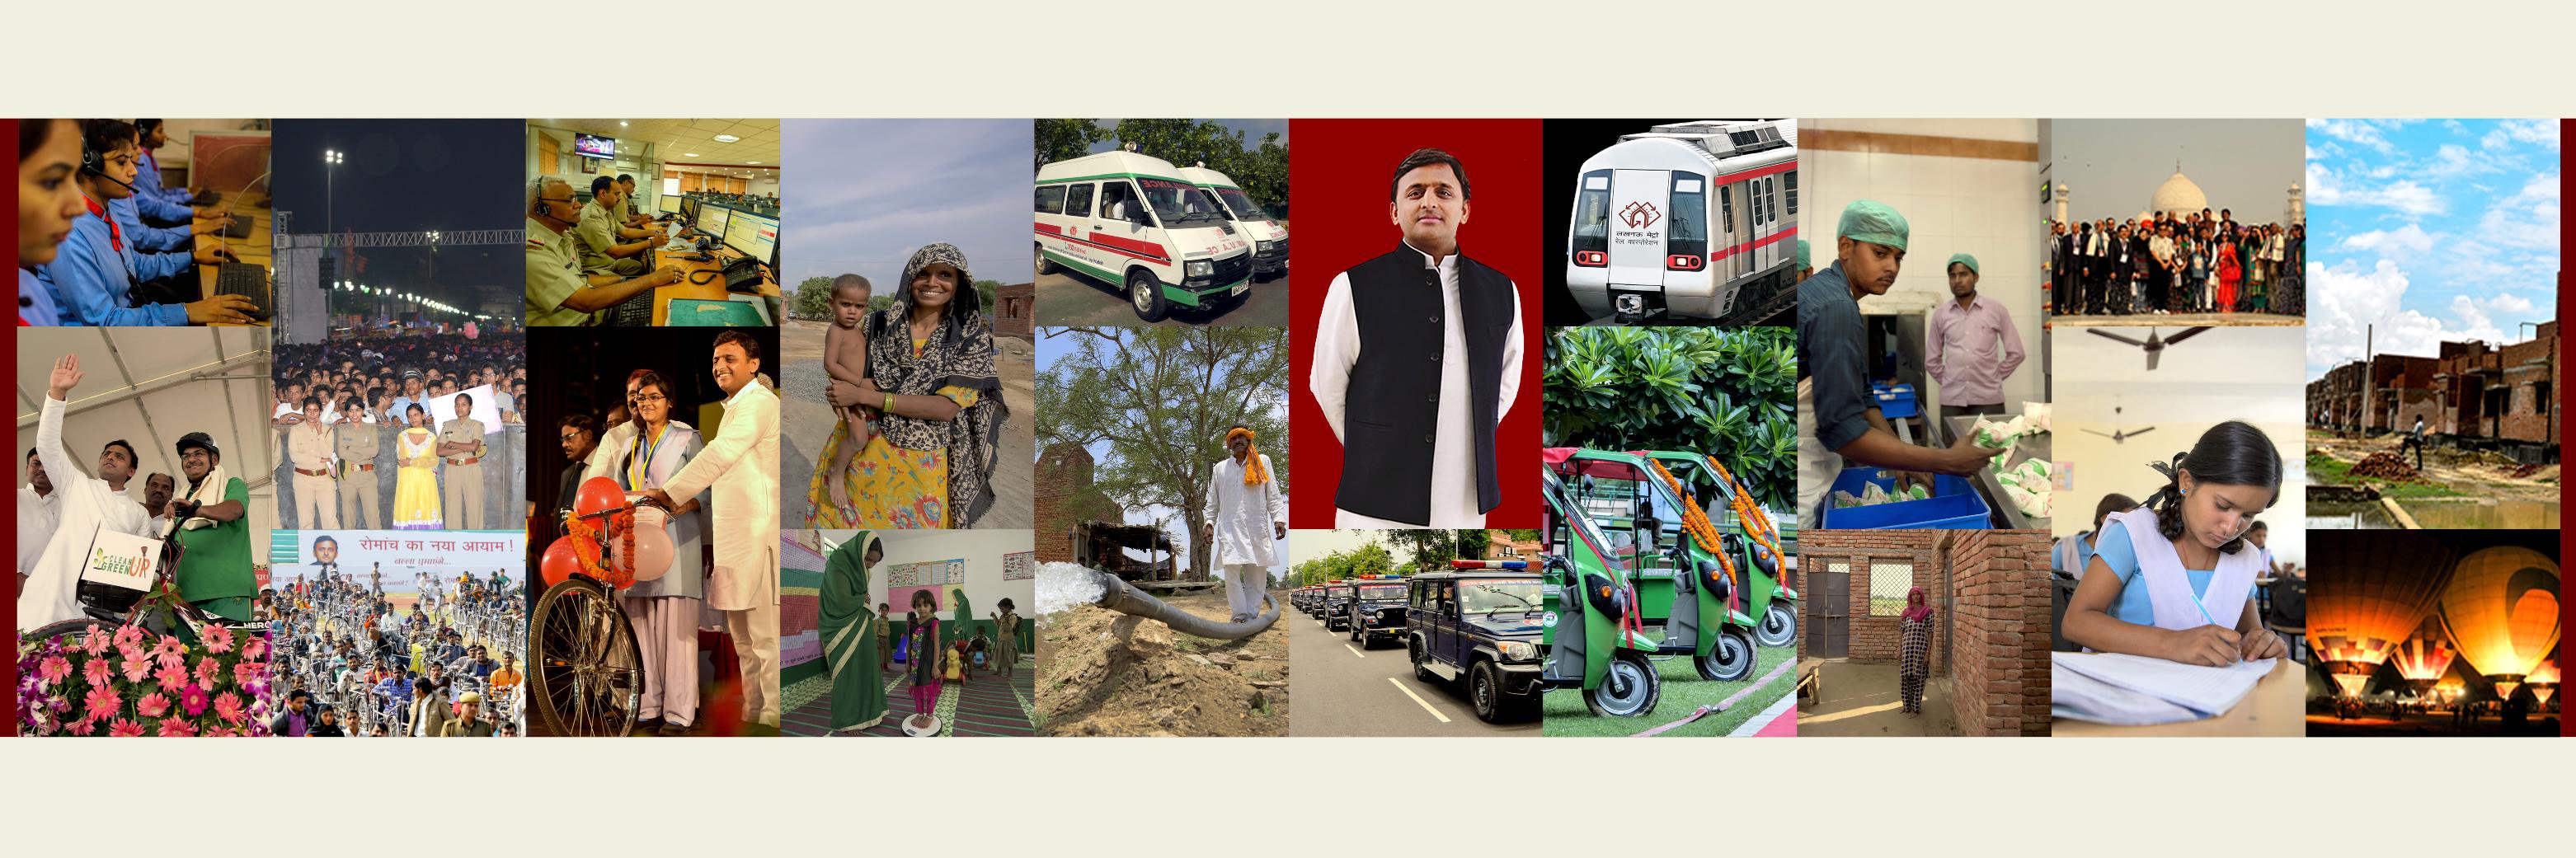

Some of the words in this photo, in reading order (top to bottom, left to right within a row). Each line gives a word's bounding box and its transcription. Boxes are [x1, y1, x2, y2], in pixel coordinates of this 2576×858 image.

[359, 536, 399, 551] रोमांच
[405, 540, 424, 551] का
[430, 541, 455, 551] नया
[462, 541, 505, 552] आयाम
[101, 561, 130, 575] GREEN
[129, 556, 150, 578] UP
[109, 555, 132, 565] CLEAN
